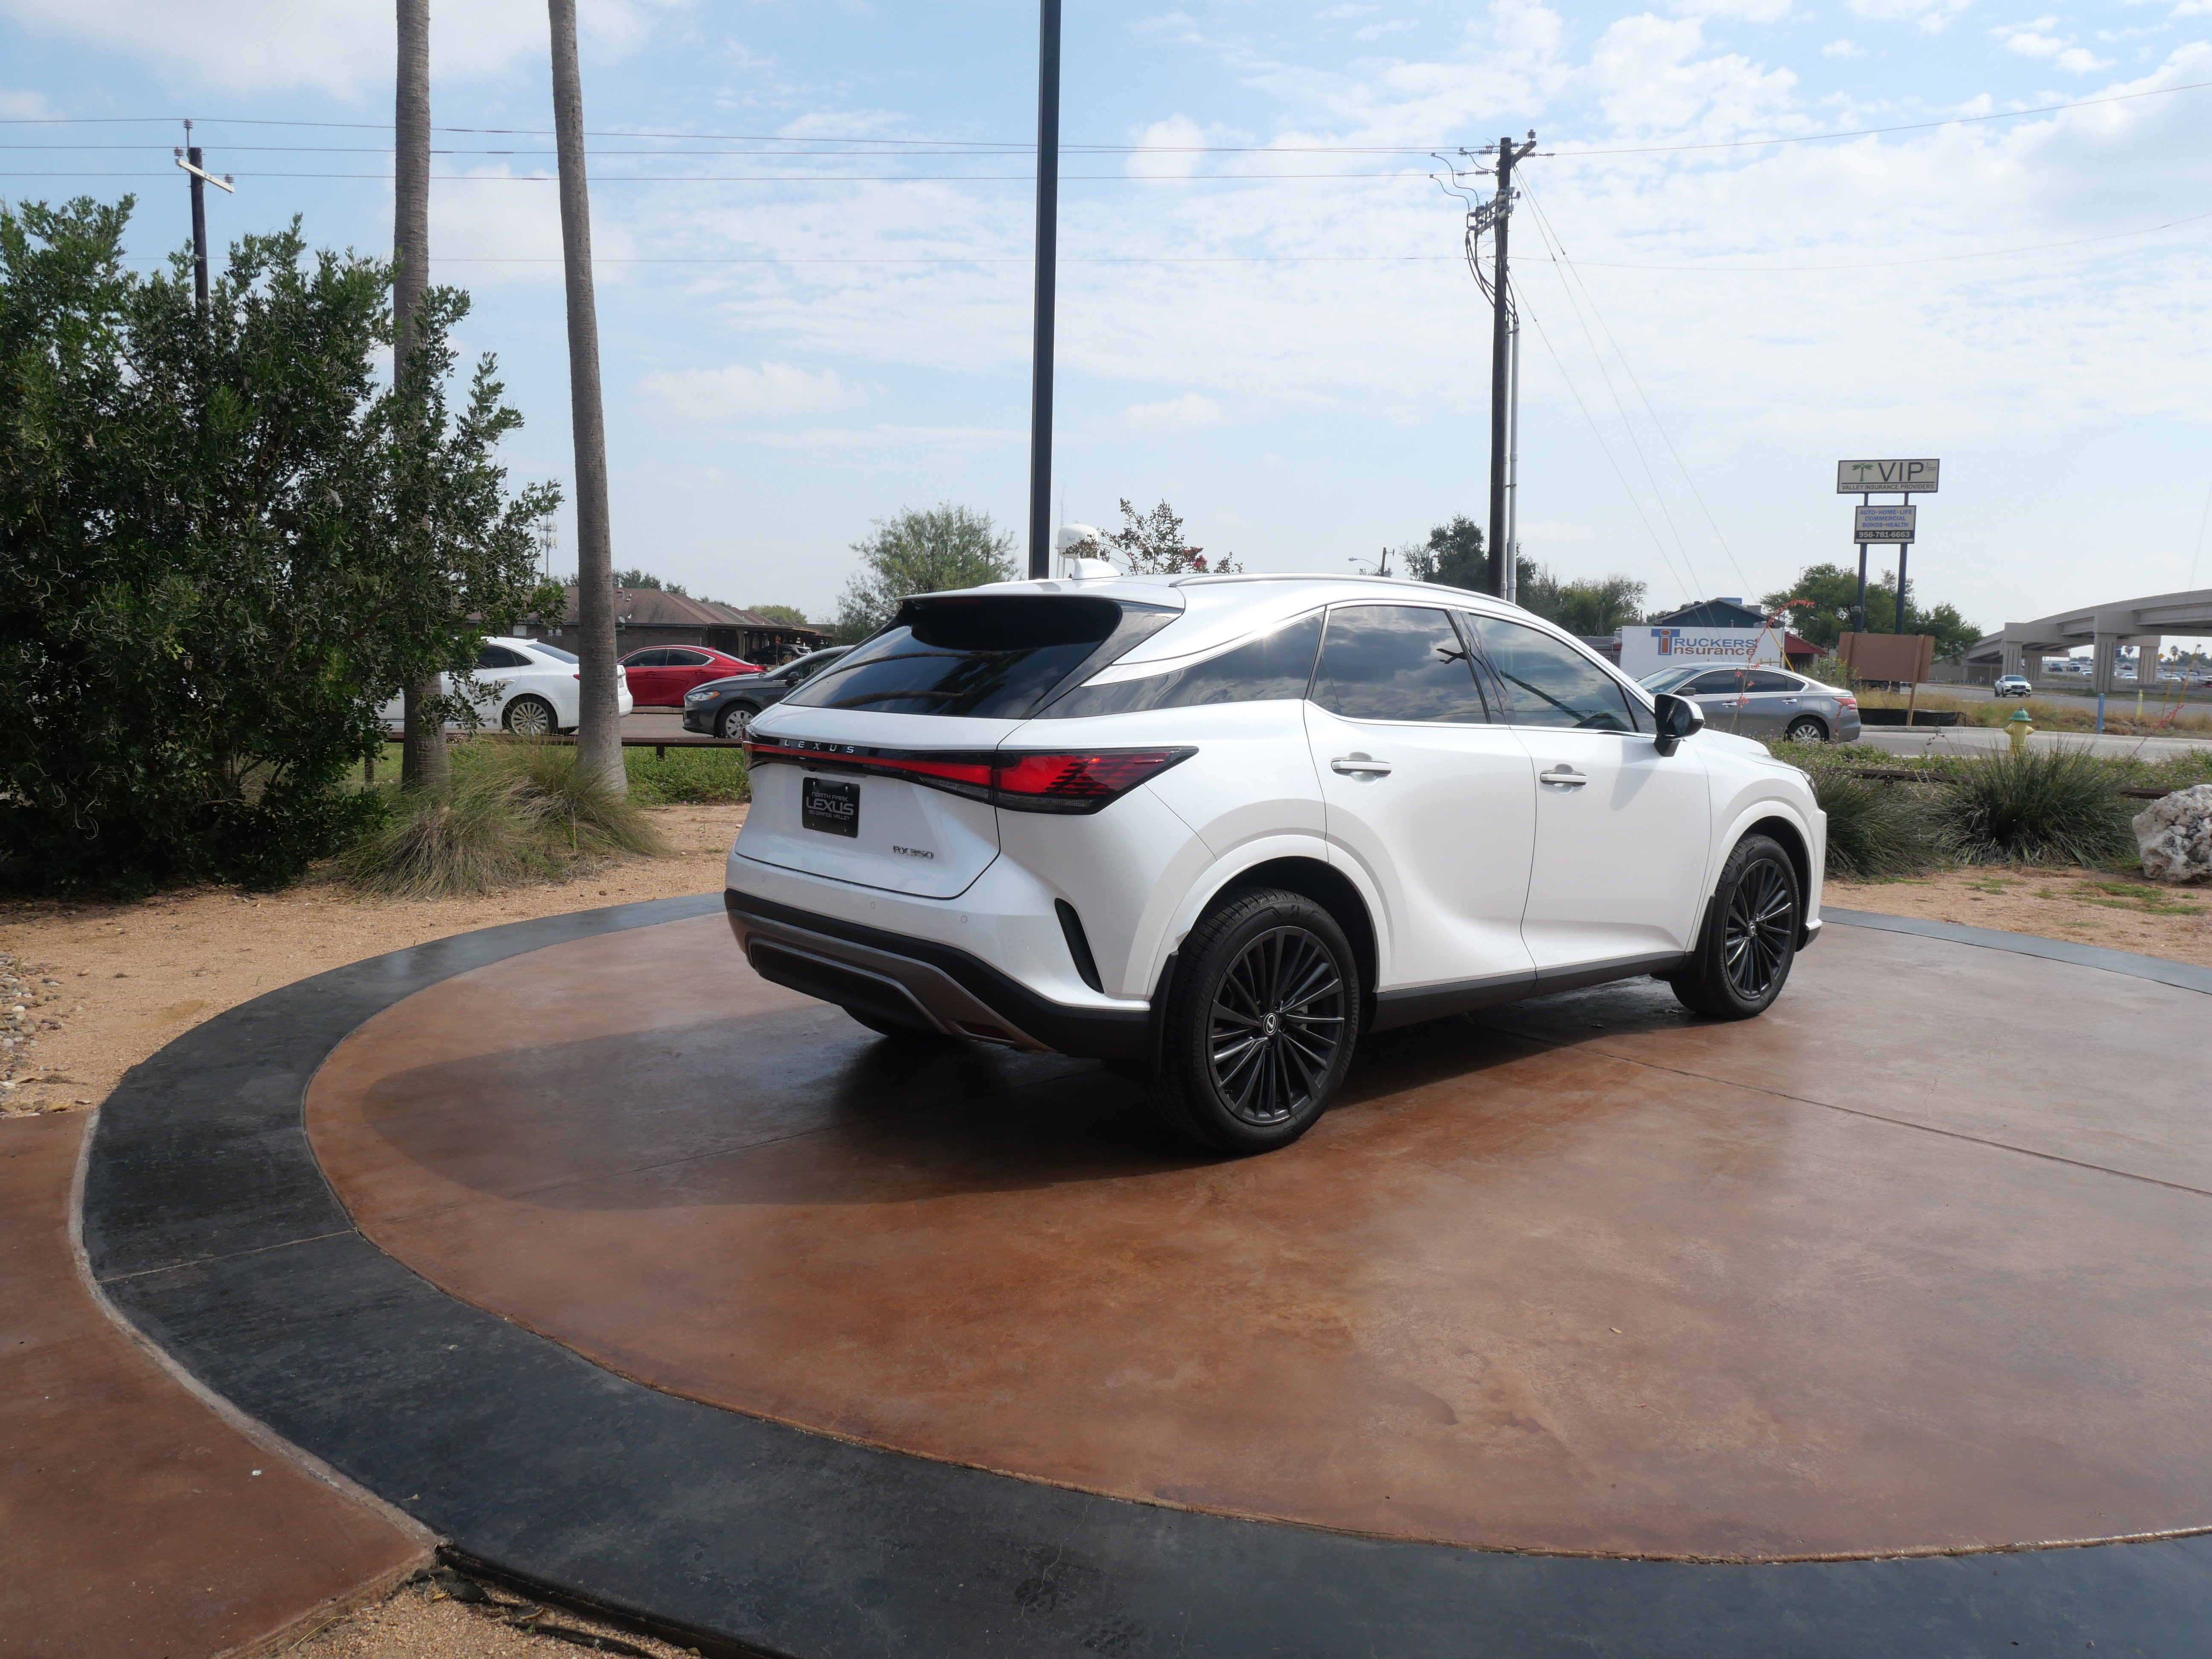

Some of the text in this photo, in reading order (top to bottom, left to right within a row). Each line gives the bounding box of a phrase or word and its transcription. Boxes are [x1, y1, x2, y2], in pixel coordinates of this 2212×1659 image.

[1878, 462, 1924, 482] VIP
[784, 739, 855, 754] LEXUS
[806, 796, 854, 816] LEXUS
[893, 846, 934, 859] RX350
